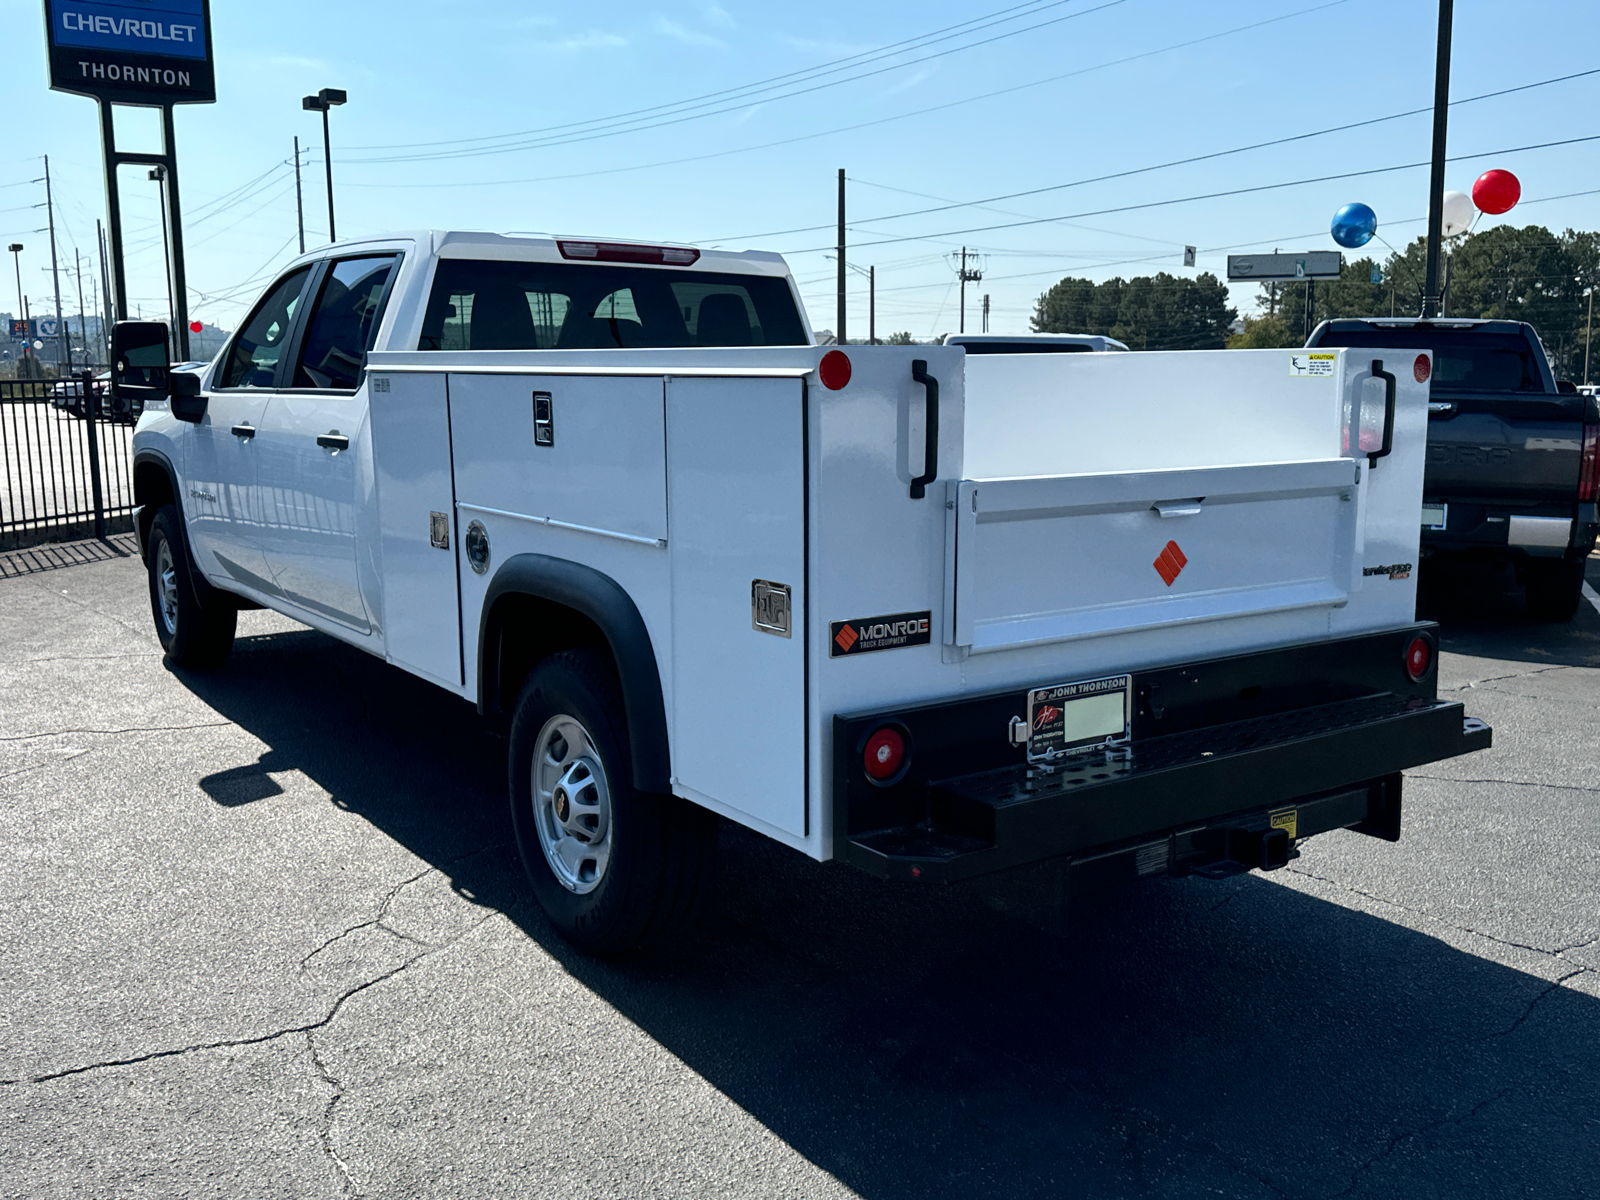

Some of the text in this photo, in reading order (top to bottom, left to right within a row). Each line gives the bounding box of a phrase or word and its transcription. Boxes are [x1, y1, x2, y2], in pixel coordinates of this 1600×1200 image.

[62, 12, 197, 43] CHEVROLET
[78, 61, 191, 87] THORNTON
[860, 619, 928, 640] MONROE
[859, 636, 908, 649] TRUCK EQUIPMENT
[1052, 686, 1077, 698] JOHN
[1078, 677, 1126, 693] THORNTON
[1066, 746, 1096, 756] CHEVROLET
[1273, 814, 1295, 826] CAUTION
